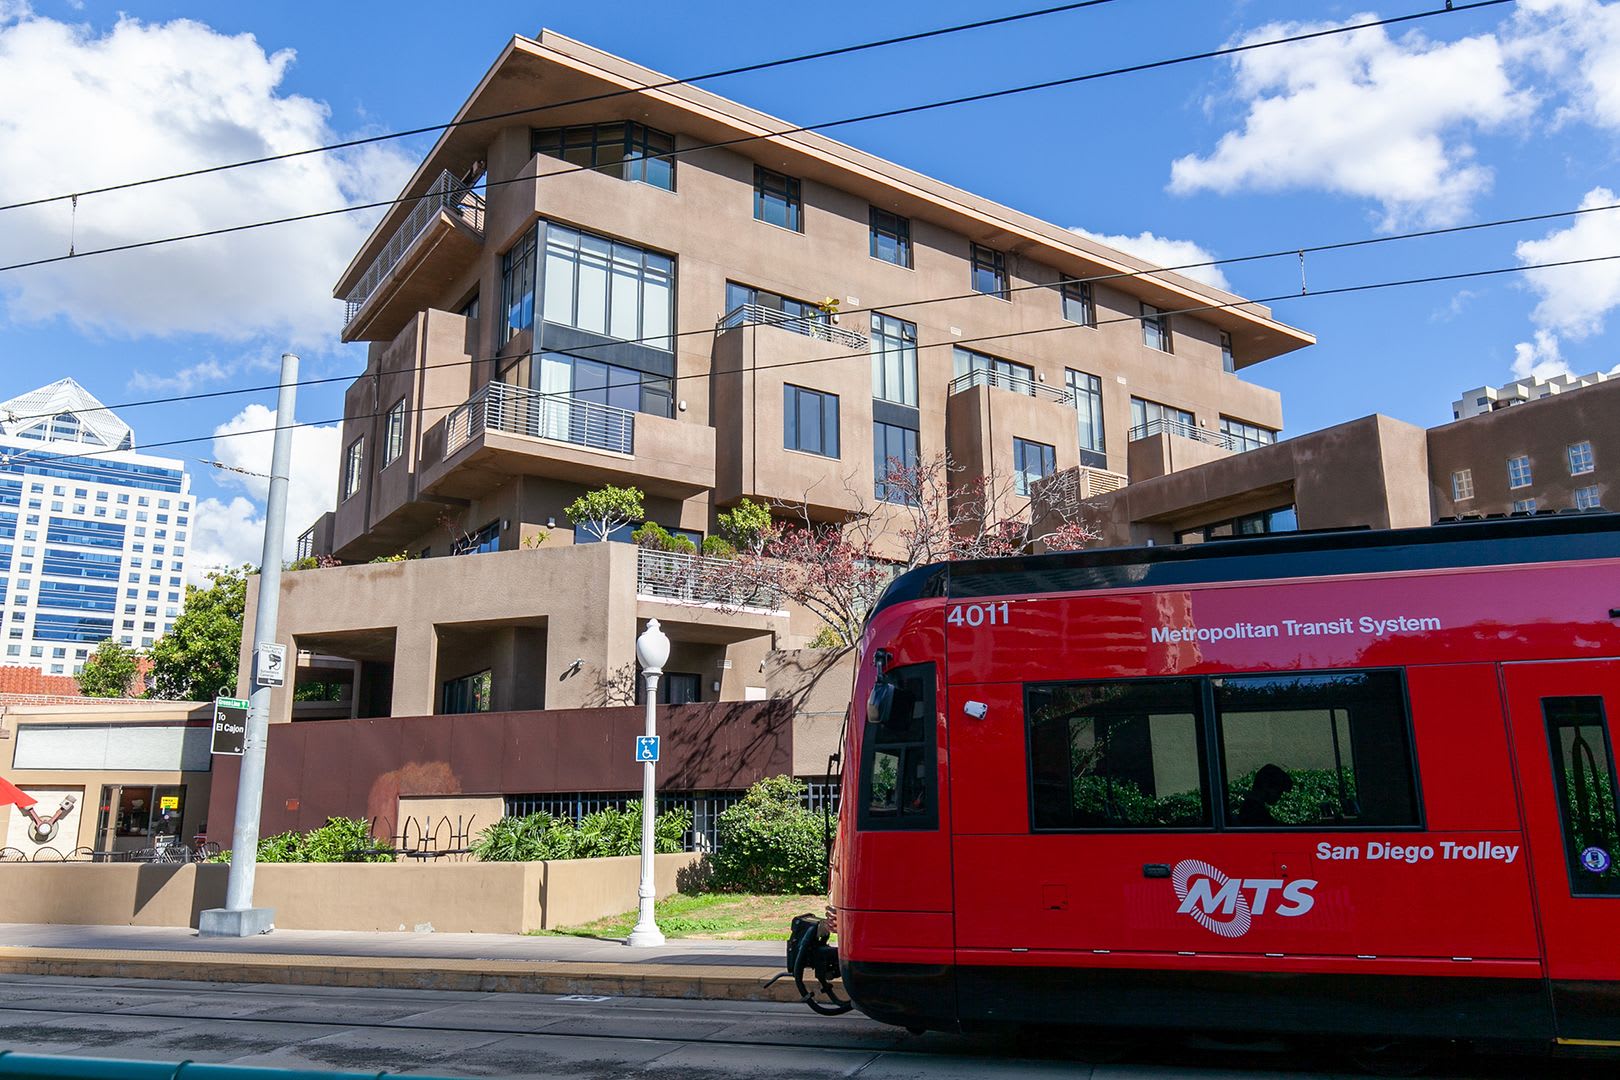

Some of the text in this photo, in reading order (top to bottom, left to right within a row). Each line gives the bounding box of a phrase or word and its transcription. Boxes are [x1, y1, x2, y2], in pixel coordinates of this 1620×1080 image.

[947, 603, 1009, 627] 4011
[1151, 615, 1441, 643] Metropolitan Transit System
[218, 712, 226, 721] To
[216, 723, 244, 734] El Cajon
[1316, 841, 1519, 864] San Diego Trolley
[1176, 879, 1318, 917] MTS
